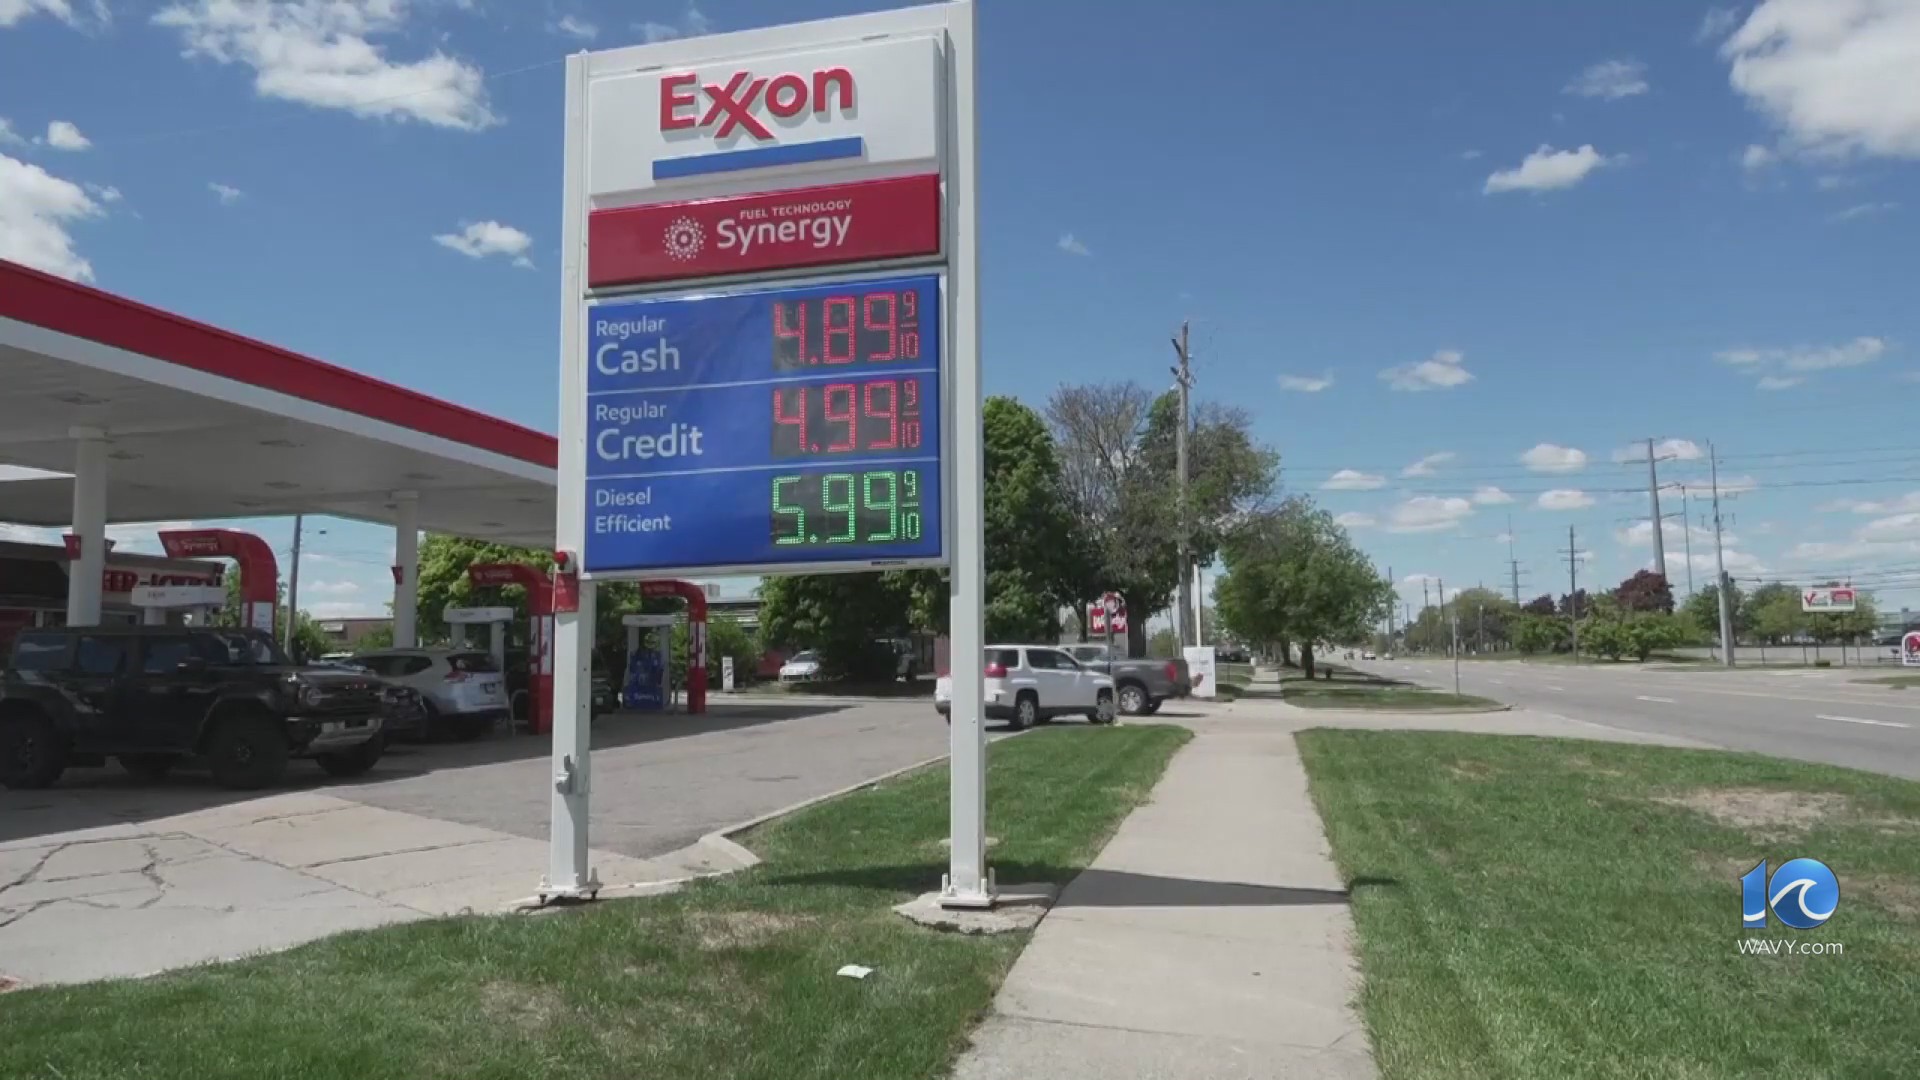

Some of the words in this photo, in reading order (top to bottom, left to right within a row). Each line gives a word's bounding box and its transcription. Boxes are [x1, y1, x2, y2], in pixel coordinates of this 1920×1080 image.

[660, 65, 854, 140] Exxon
[739, 207, 769, 220] FUEL
[771, 198, 852, 217] TECHNOLOGY
[716, 214, 852, 256] Synergy
[595, 316, 667, 341] Regular
[772, 291, 898, 365] 4.89
[595, 338, 680, 376] Cash
[595, 401, 668, 425] Regular
[772, 379, 898, 454] 4.99
[595, 423, 704, 461] Credit
[594, 486, 652, 507] Diesel
[771, 470, 898, 546] 5.99
[594, 515, 673, 534] Efficient
